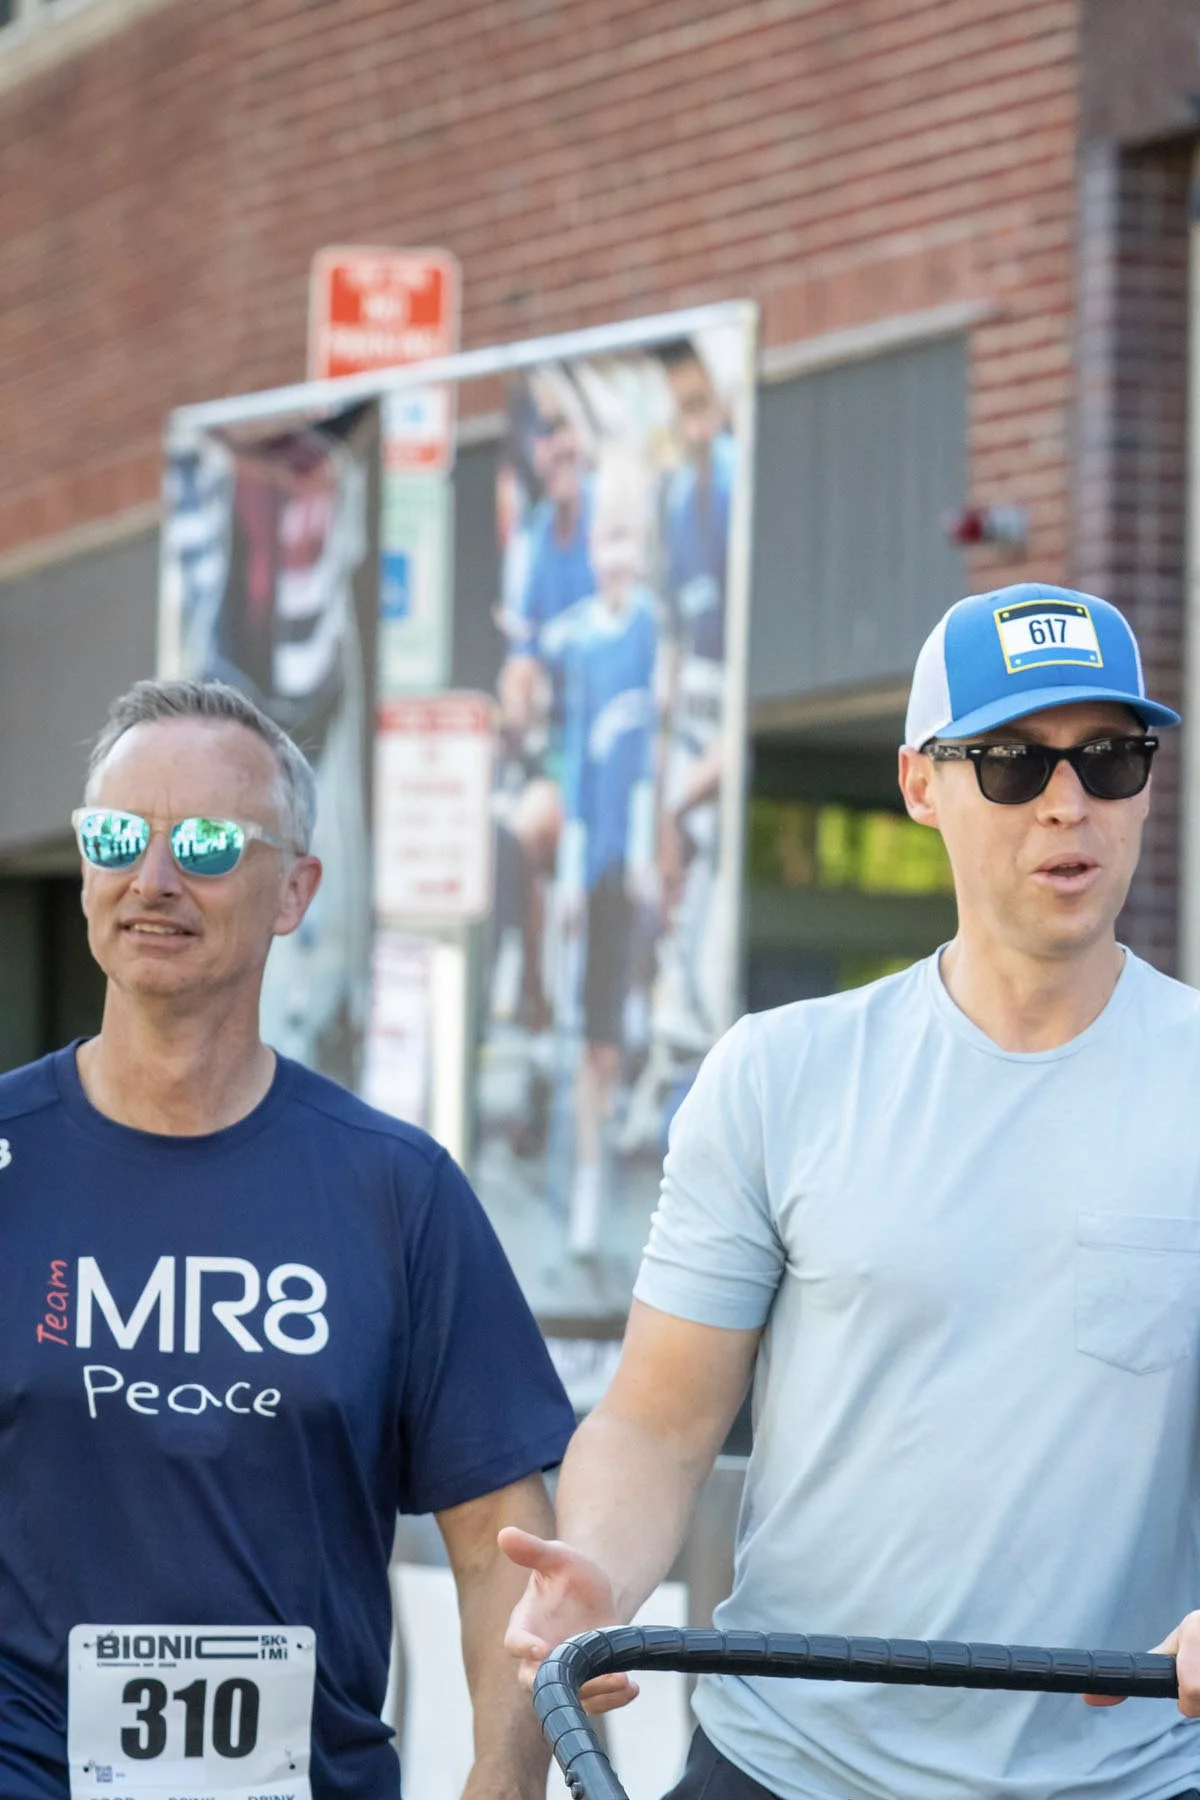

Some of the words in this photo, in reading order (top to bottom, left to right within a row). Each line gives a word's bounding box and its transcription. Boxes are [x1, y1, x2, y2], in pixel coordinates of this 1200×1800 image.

[1029, 619, 1067, 645] 617
[37, 1260, 69, 1346] Team
[76, 1256, 329, 1355] MR8
[84, 1365, 281, 1419] Peace
[97, 1635, 259, 1660] BIONIC
[120, 1677, 260, 1760] 310
